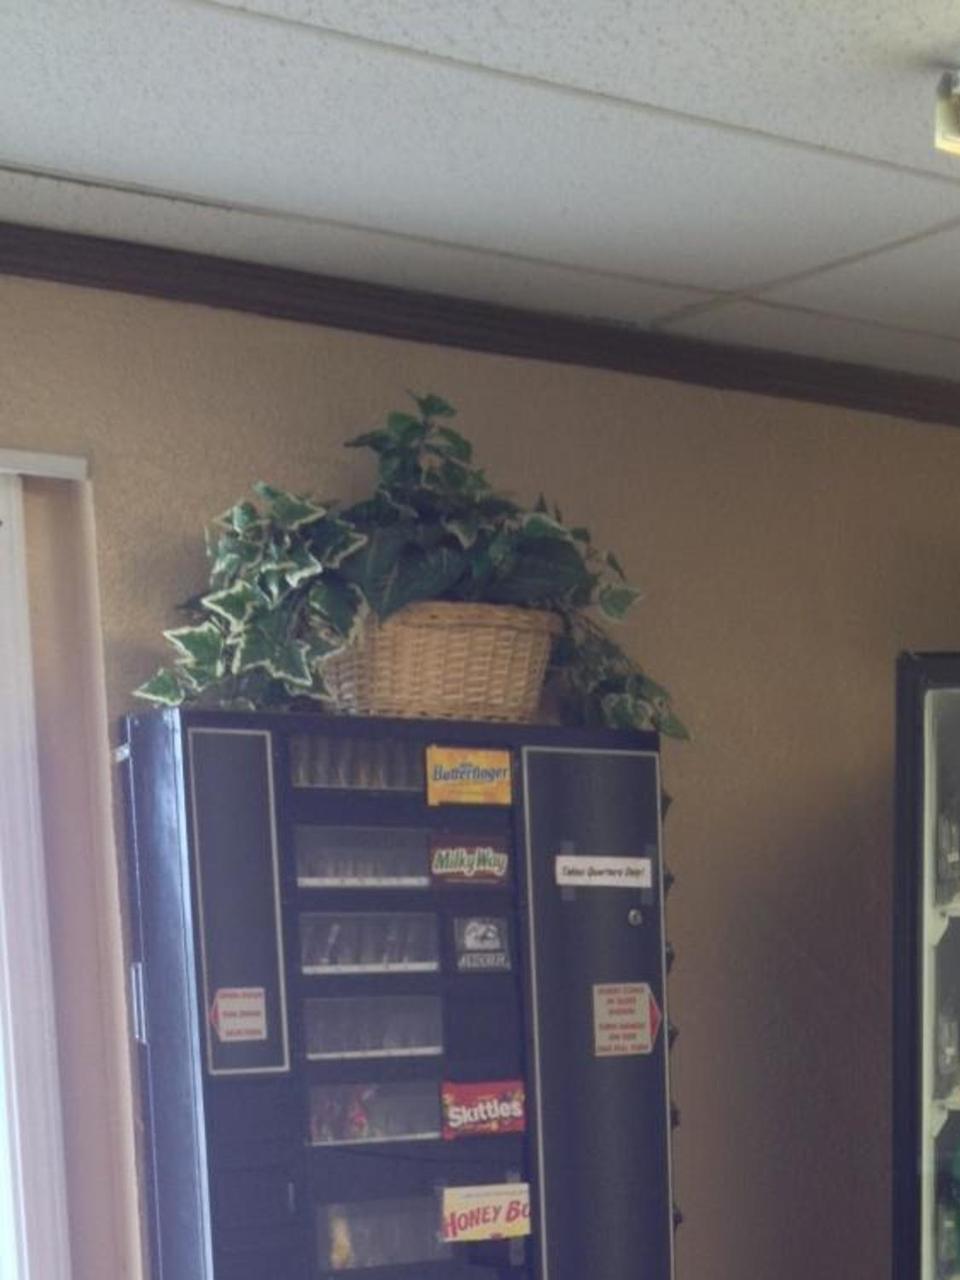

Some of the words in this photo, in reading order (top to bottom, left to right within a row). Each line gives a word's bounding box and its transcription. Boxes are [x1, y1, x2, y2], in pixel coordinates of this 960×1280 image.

[432, 763, 509, 782] Butterfinger
[449, 1099, 522, 1128] Skittles
[442, 1204, 502, 1238] HONEY
